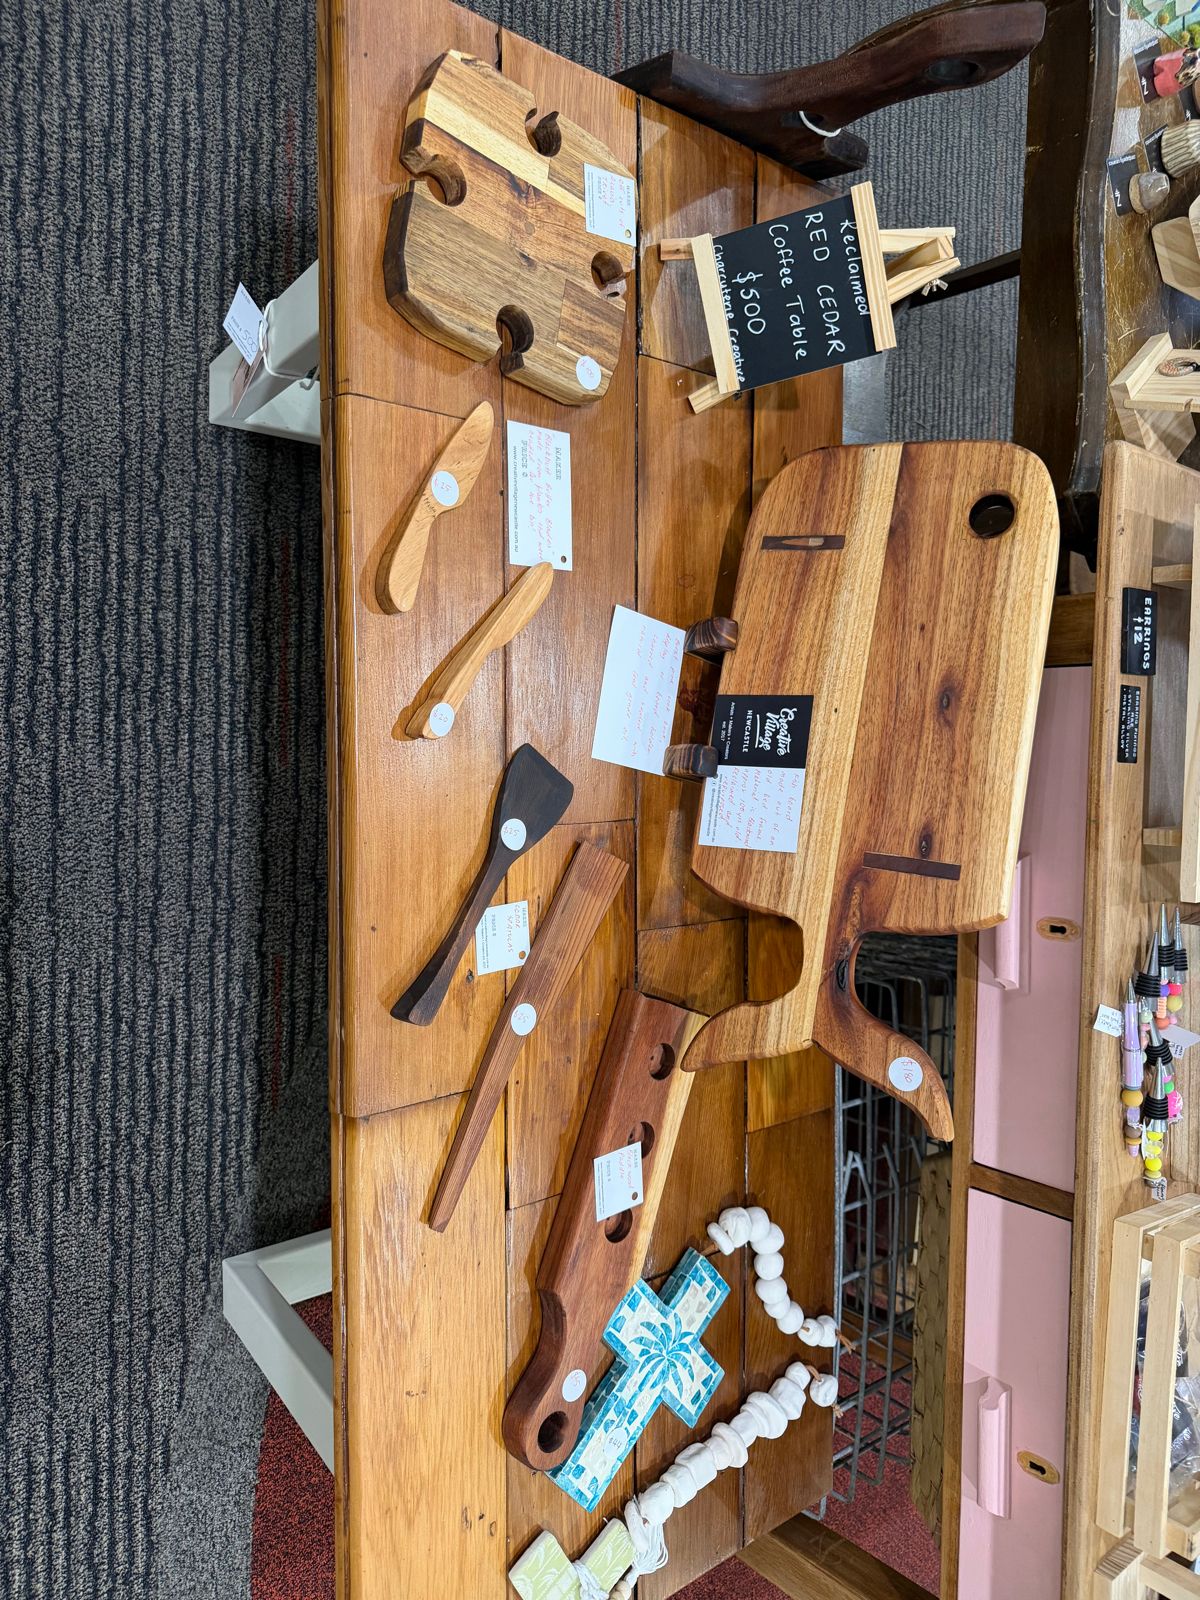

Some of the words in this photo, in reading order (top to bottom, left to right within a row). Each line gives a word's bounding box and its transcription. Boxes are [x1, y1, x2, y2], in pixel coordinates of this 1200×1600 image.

[804, 212, 830, 262] RED
[840, 219, 870, 316] Reclaimed
[732, 272, 766, 335] $500
[768, 224, 794, 288] Coffee
[786, 295, 808, 360] Table
[816, 284, 846, 356] CEDAR
[1142, 598, 1152, 670] EARRINGS
[742, 710, 753, 753] NEWCASTLE
[758, 712, 780, 751] Village
[776, 708, 798, 756] Creative
